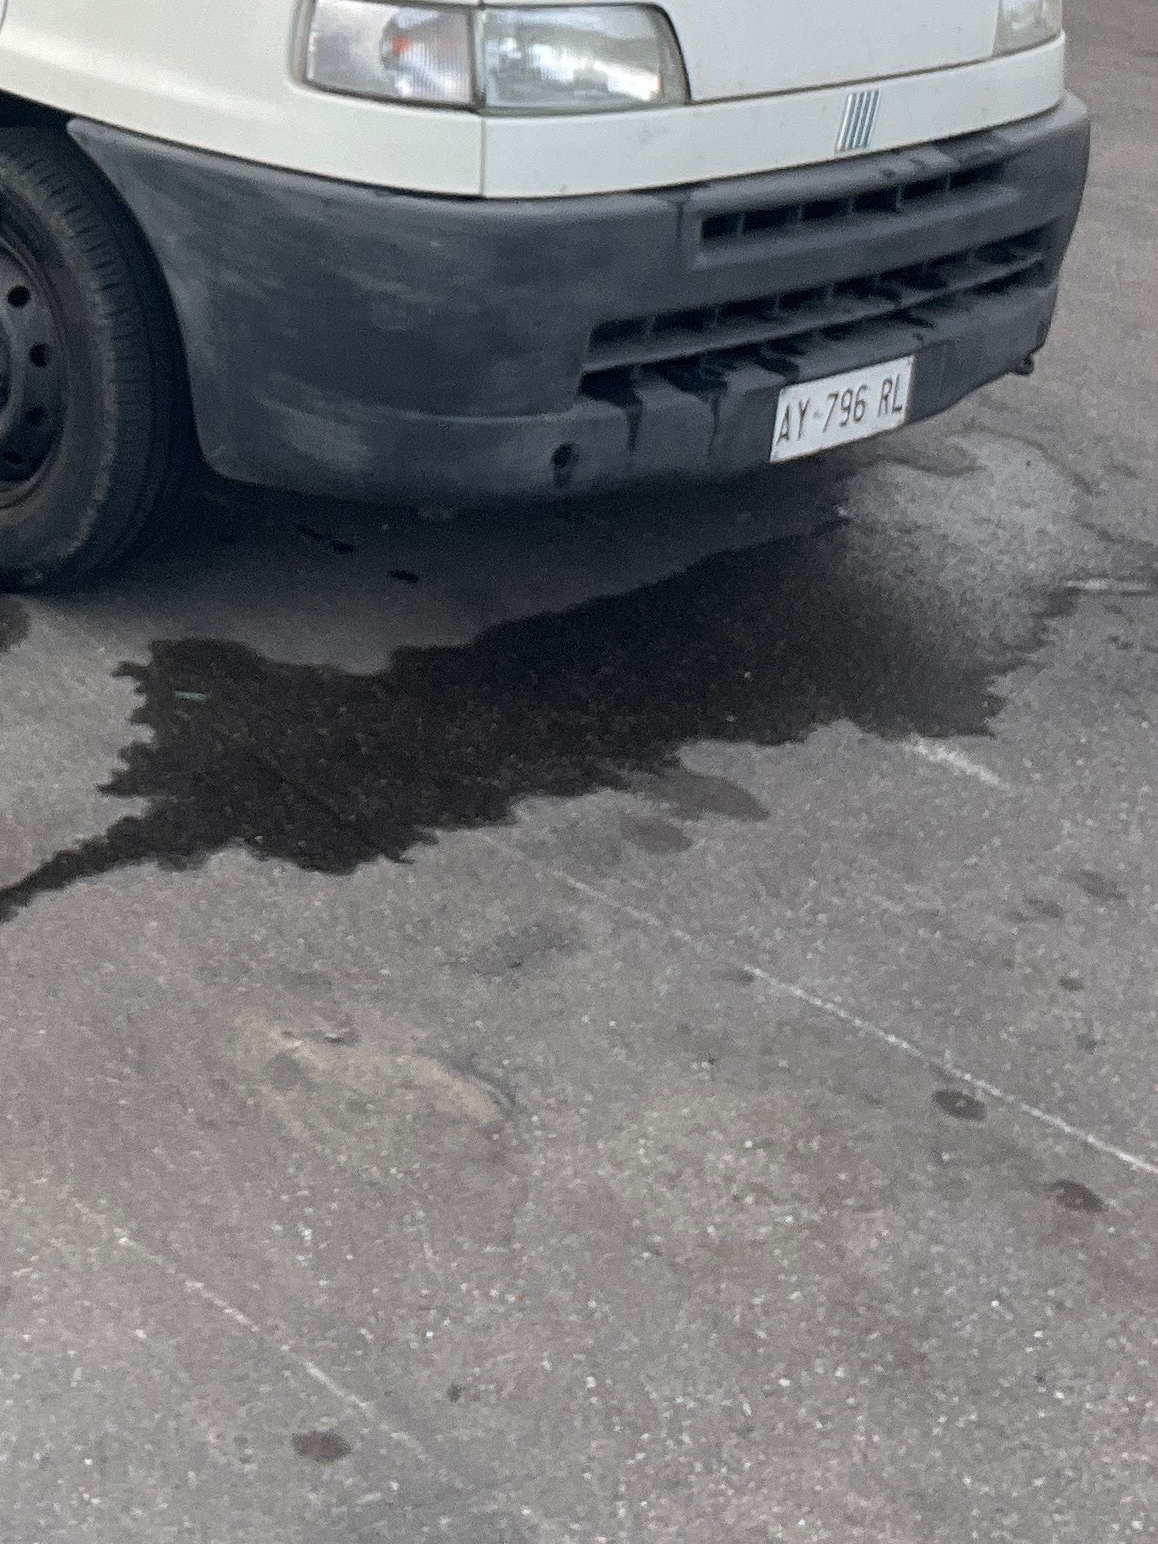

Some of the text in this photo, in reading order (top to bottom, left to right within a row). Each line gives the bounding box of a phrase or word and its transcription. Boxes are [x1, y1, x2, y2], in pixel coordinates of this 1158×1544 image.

[776, 374, 903, 446] AY 796 RL
